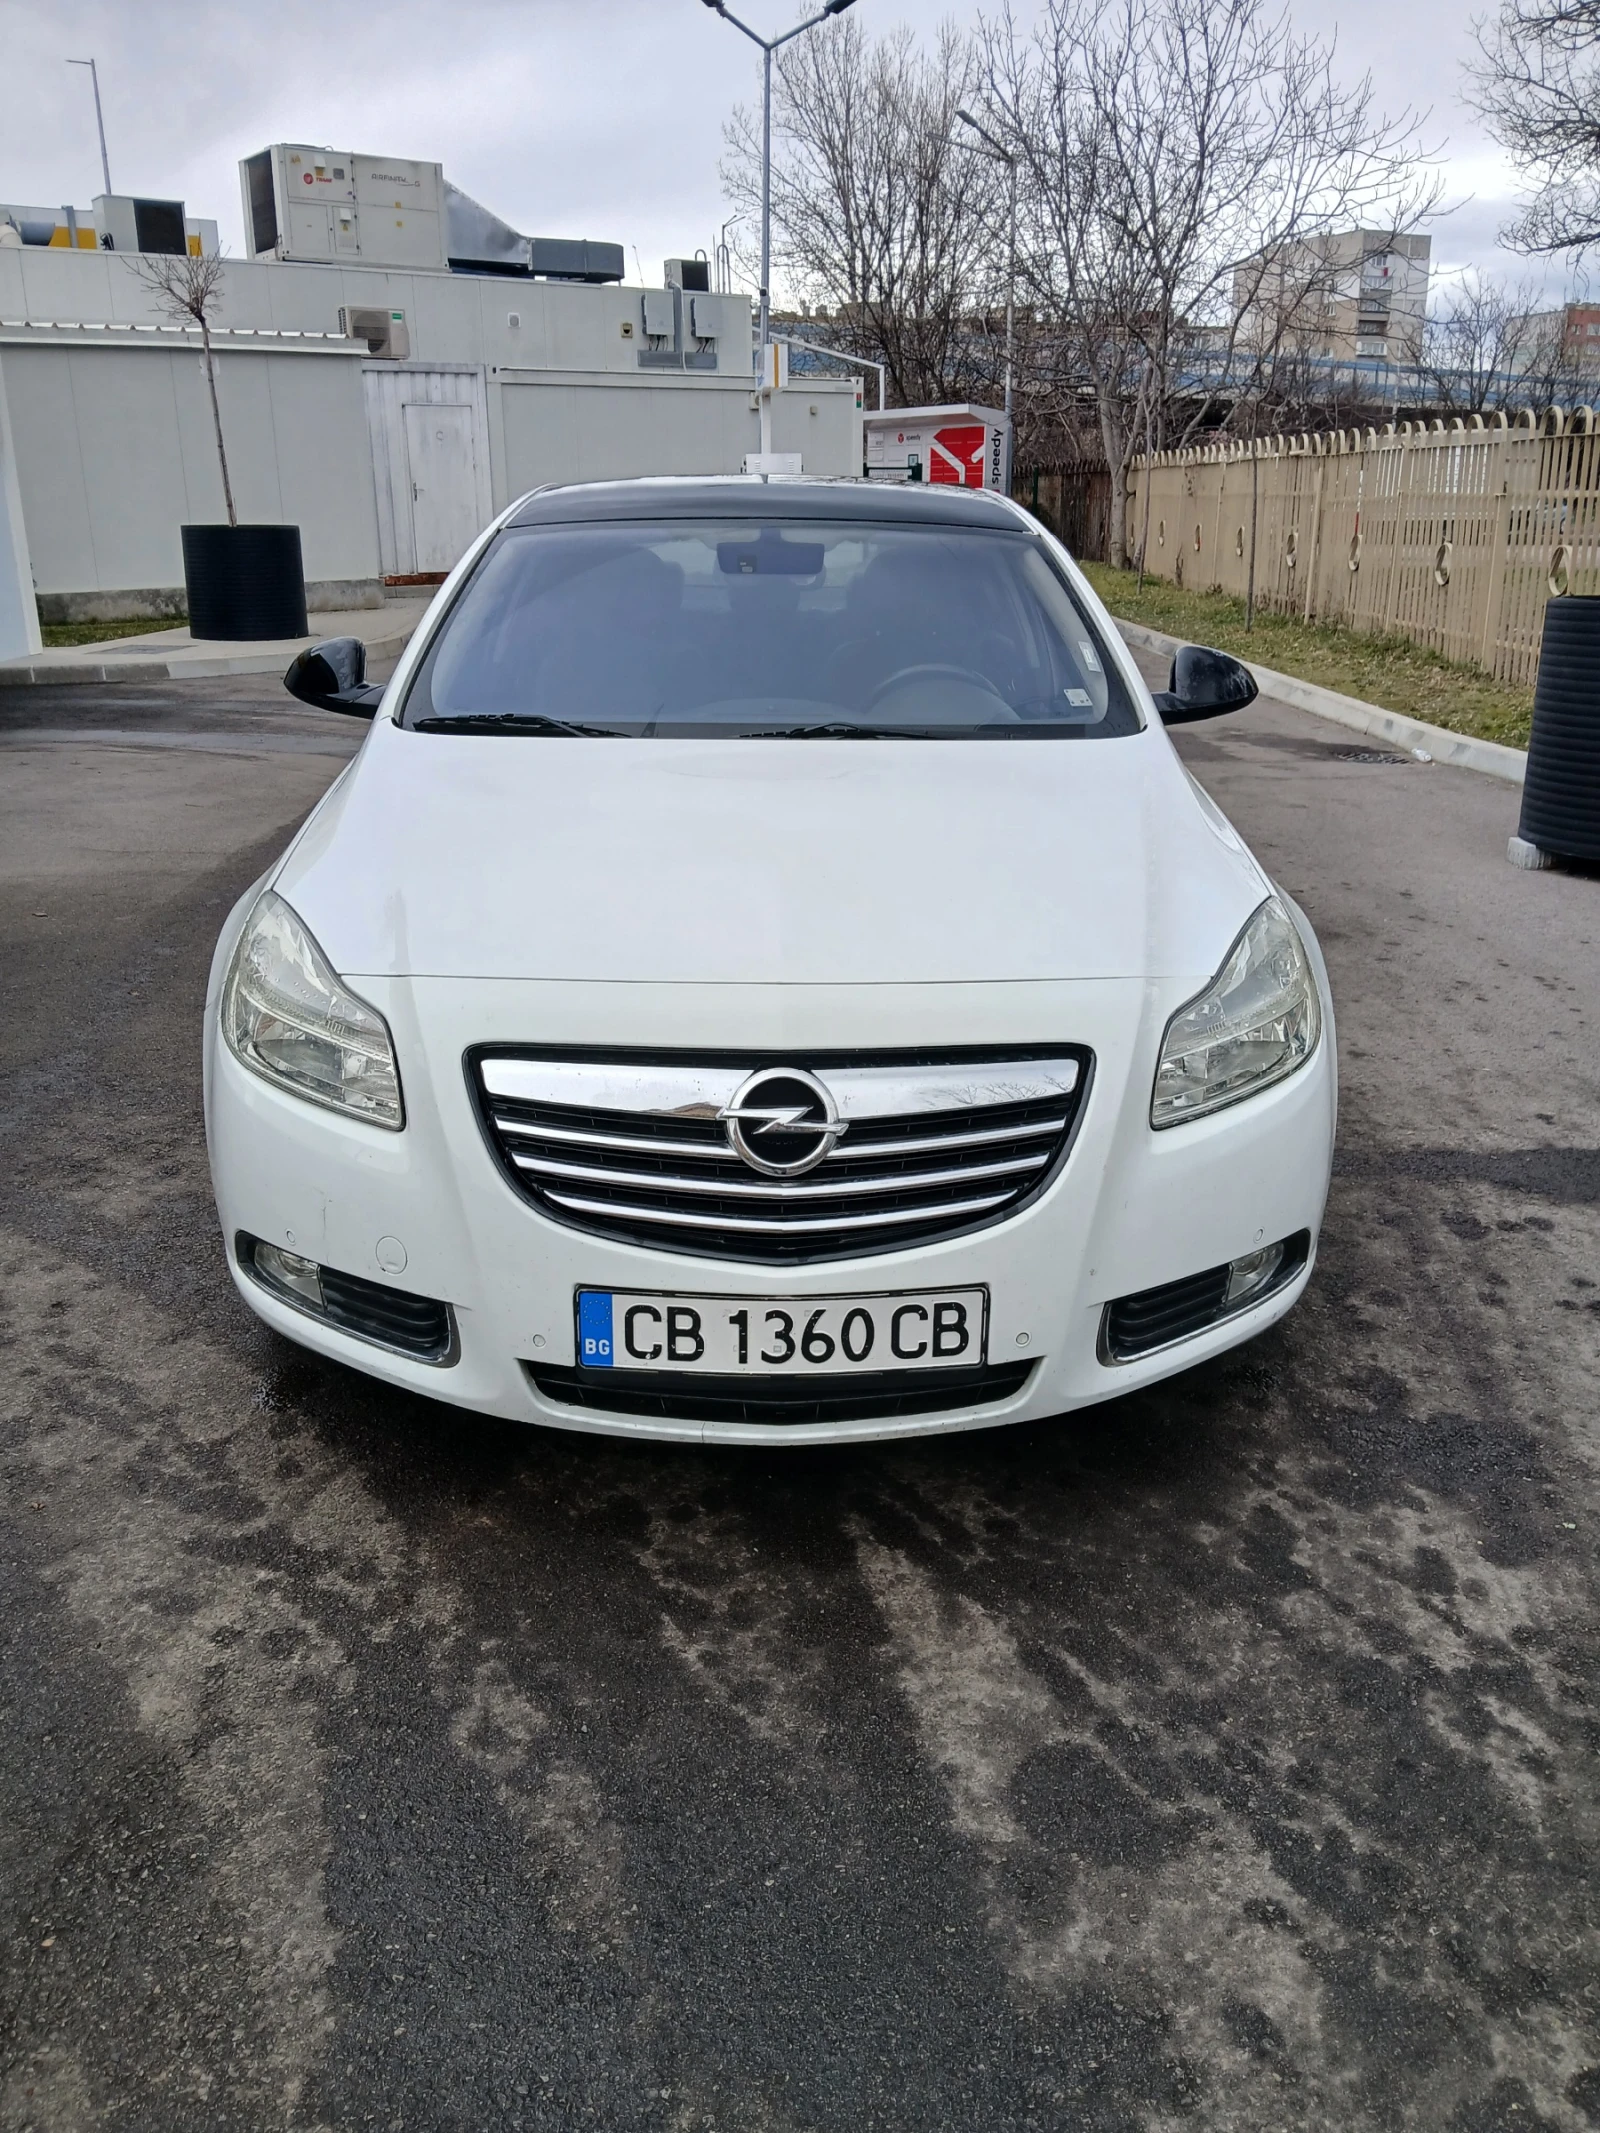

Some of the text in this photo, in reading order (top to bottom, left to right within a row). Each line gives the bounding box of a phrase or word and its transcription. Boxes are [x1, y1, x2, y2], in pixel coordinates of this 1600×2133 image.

[371, 173, 406, 182] AIRFINITY
[991, 428, 1003, 484] speedy
[584, 1339, 610, 1356] BG
[624, 1301, 970, 1365] CB 1360 CB
